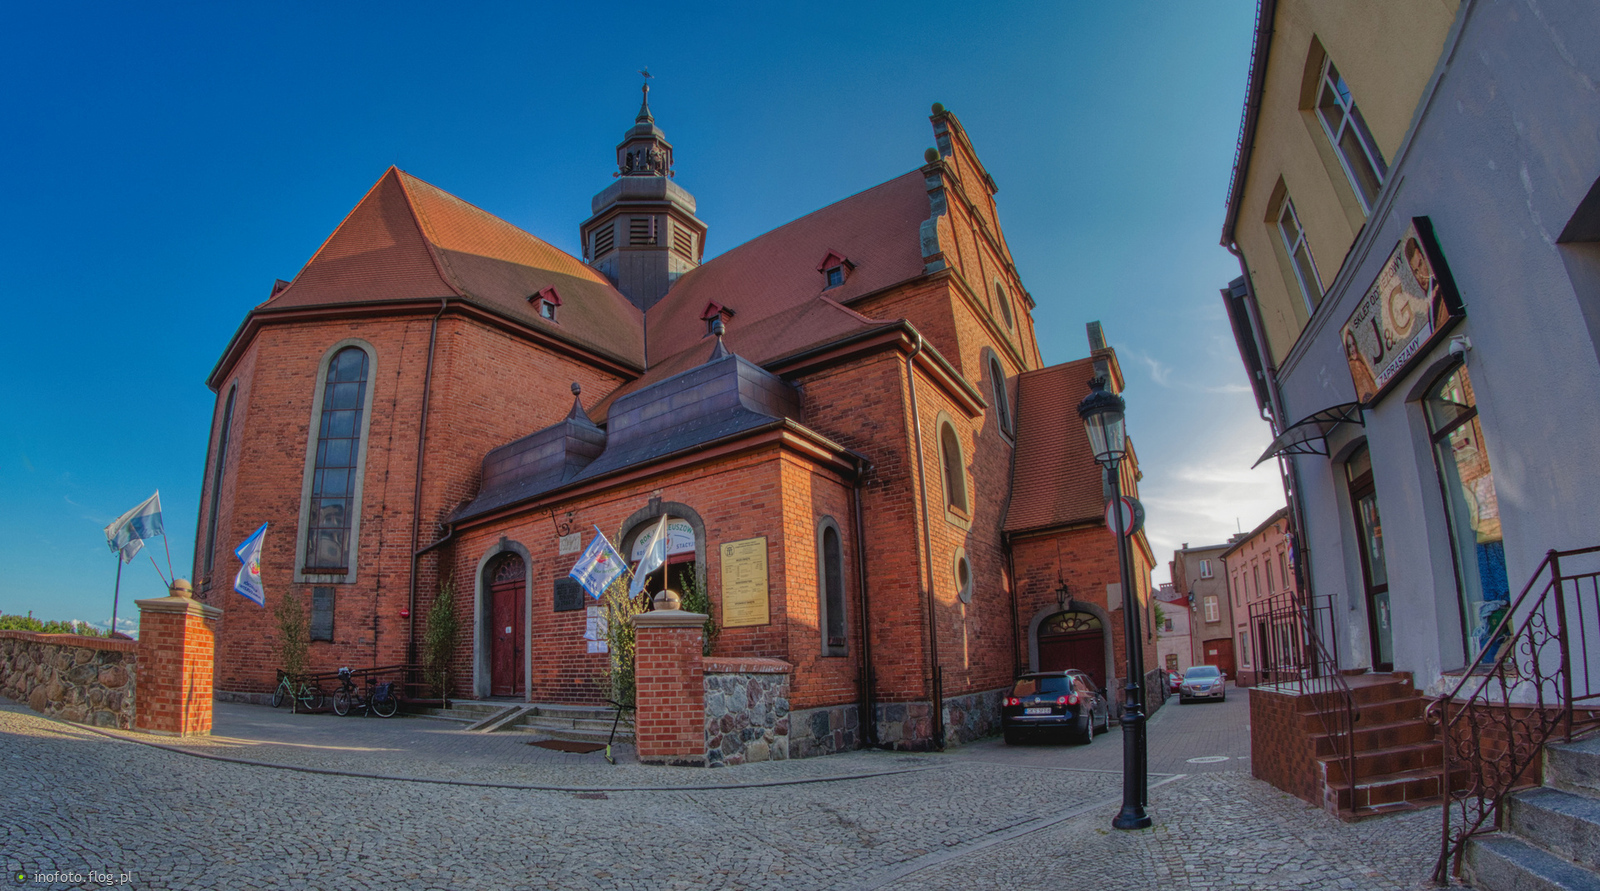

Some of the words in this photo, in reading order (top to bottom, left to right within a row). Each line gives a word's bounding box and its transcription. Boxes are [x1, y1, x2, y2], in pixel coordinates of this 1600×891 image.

[1353, 301, 1370, 329] SKLEP
[1378, 336, 1420, 386] ZAPRASZAMY
[639, 533, 652, 546] ROK
[676, 541, 695, 549] STACYJ
